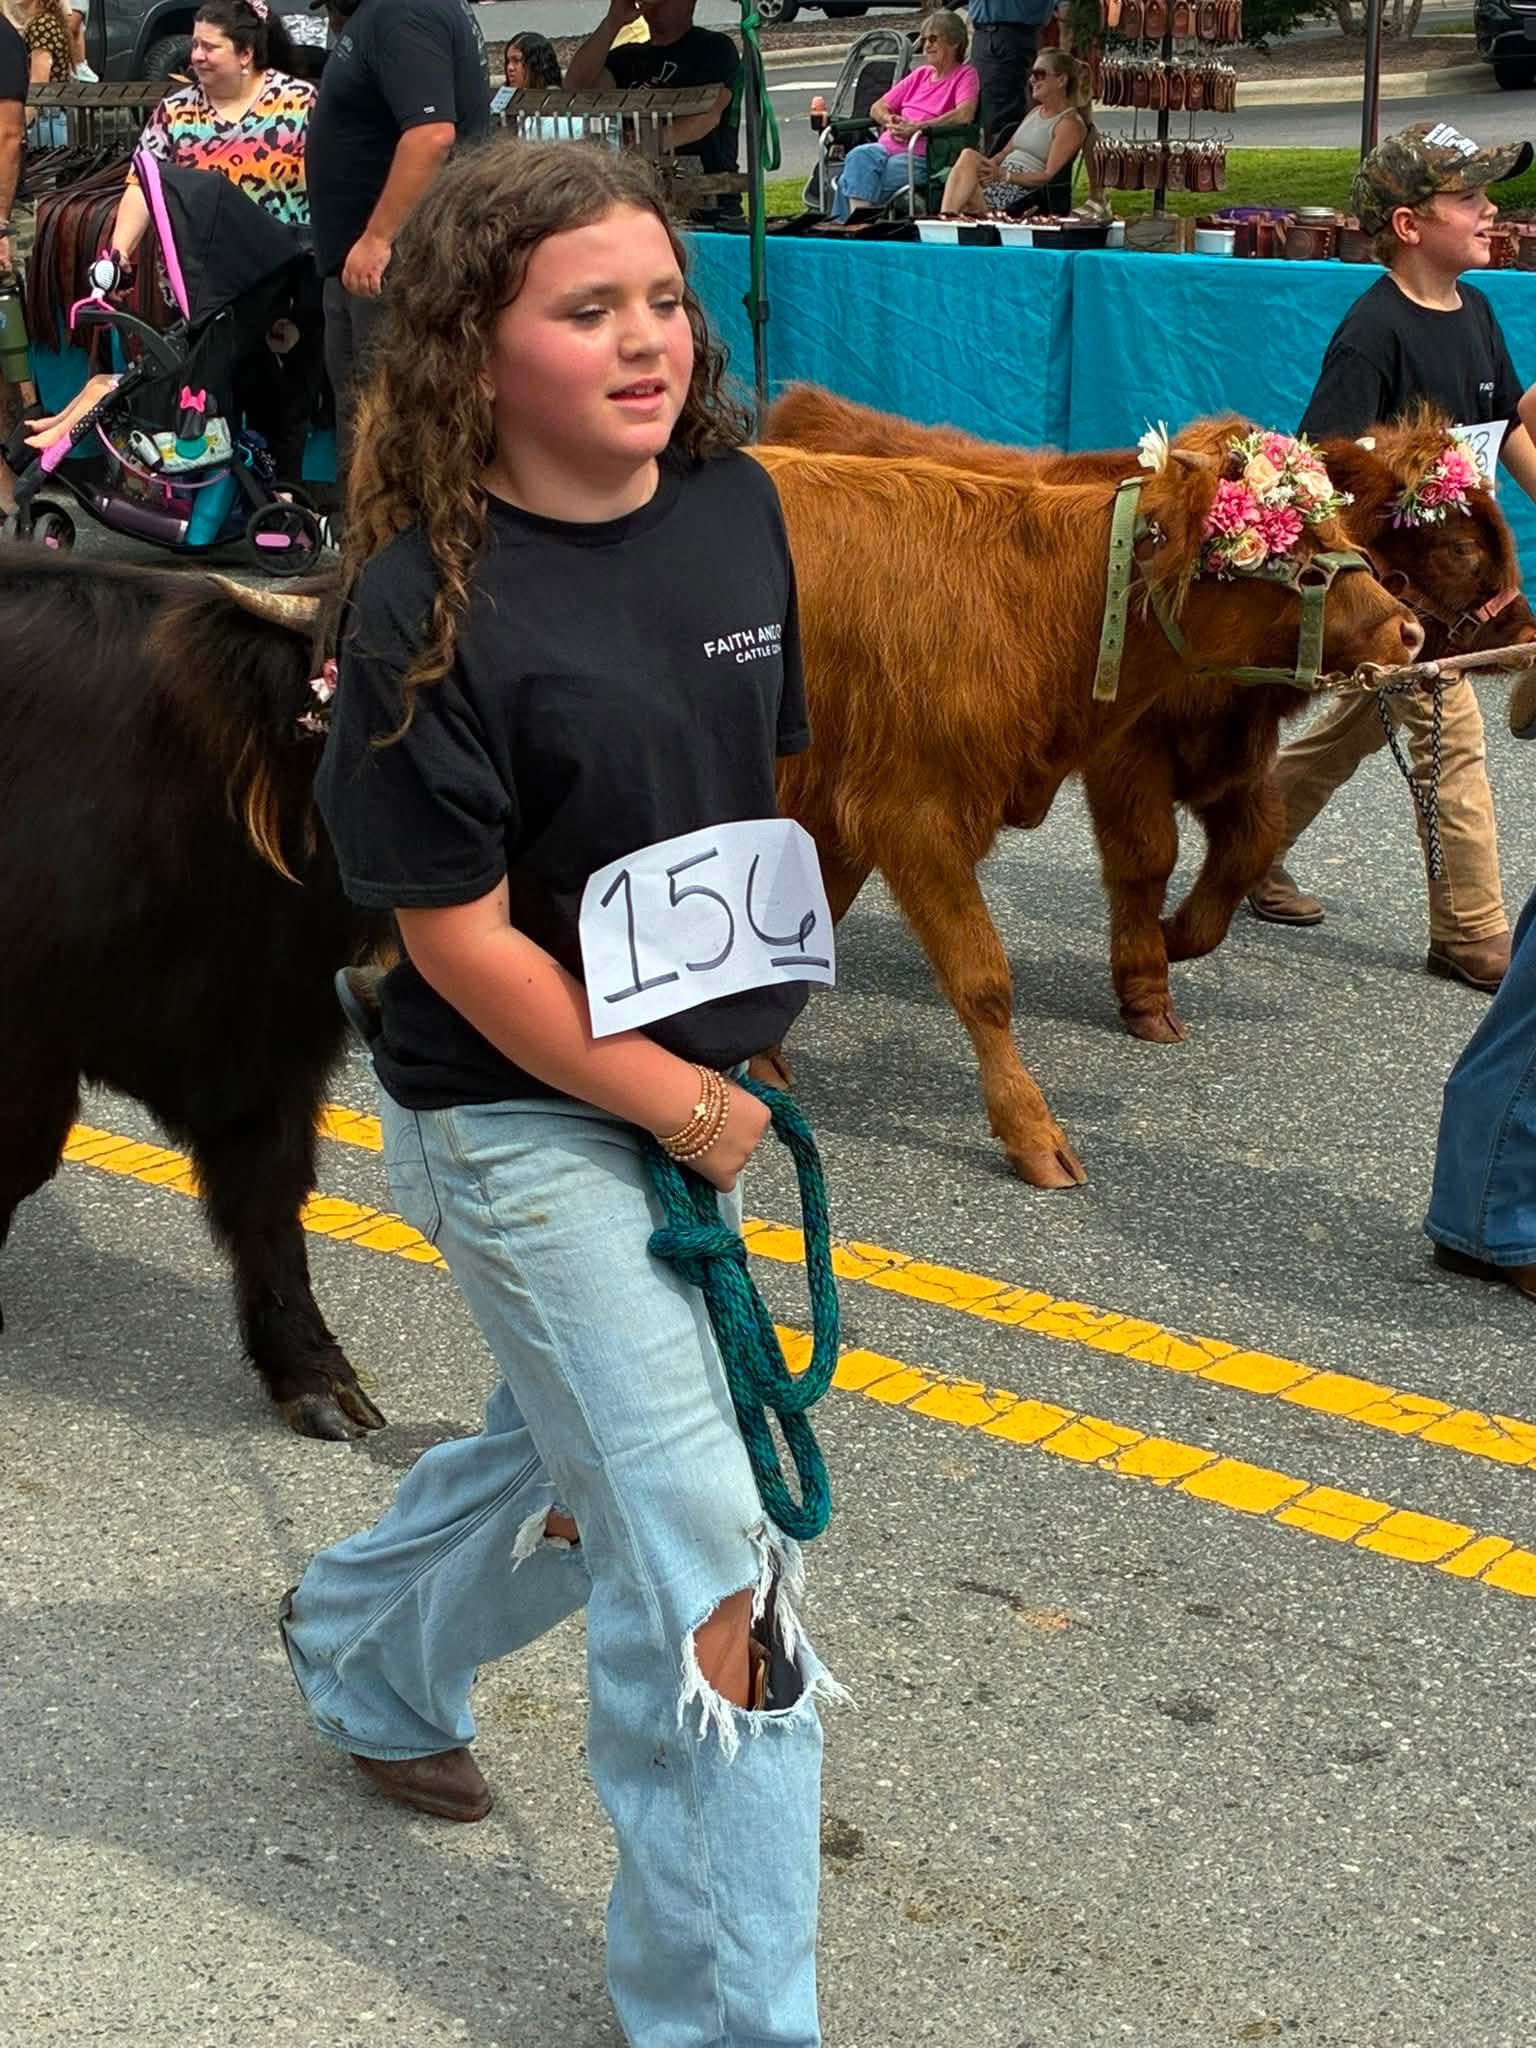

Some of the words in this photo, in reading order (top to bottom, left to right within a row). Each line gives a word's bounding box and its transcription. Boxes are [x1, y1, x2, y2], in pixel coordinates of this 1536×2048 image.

[703, 629, 756, 659] FAITH
[735, 645, 771, 664] CATTLE
[600, 847, 830, 1004] 156
